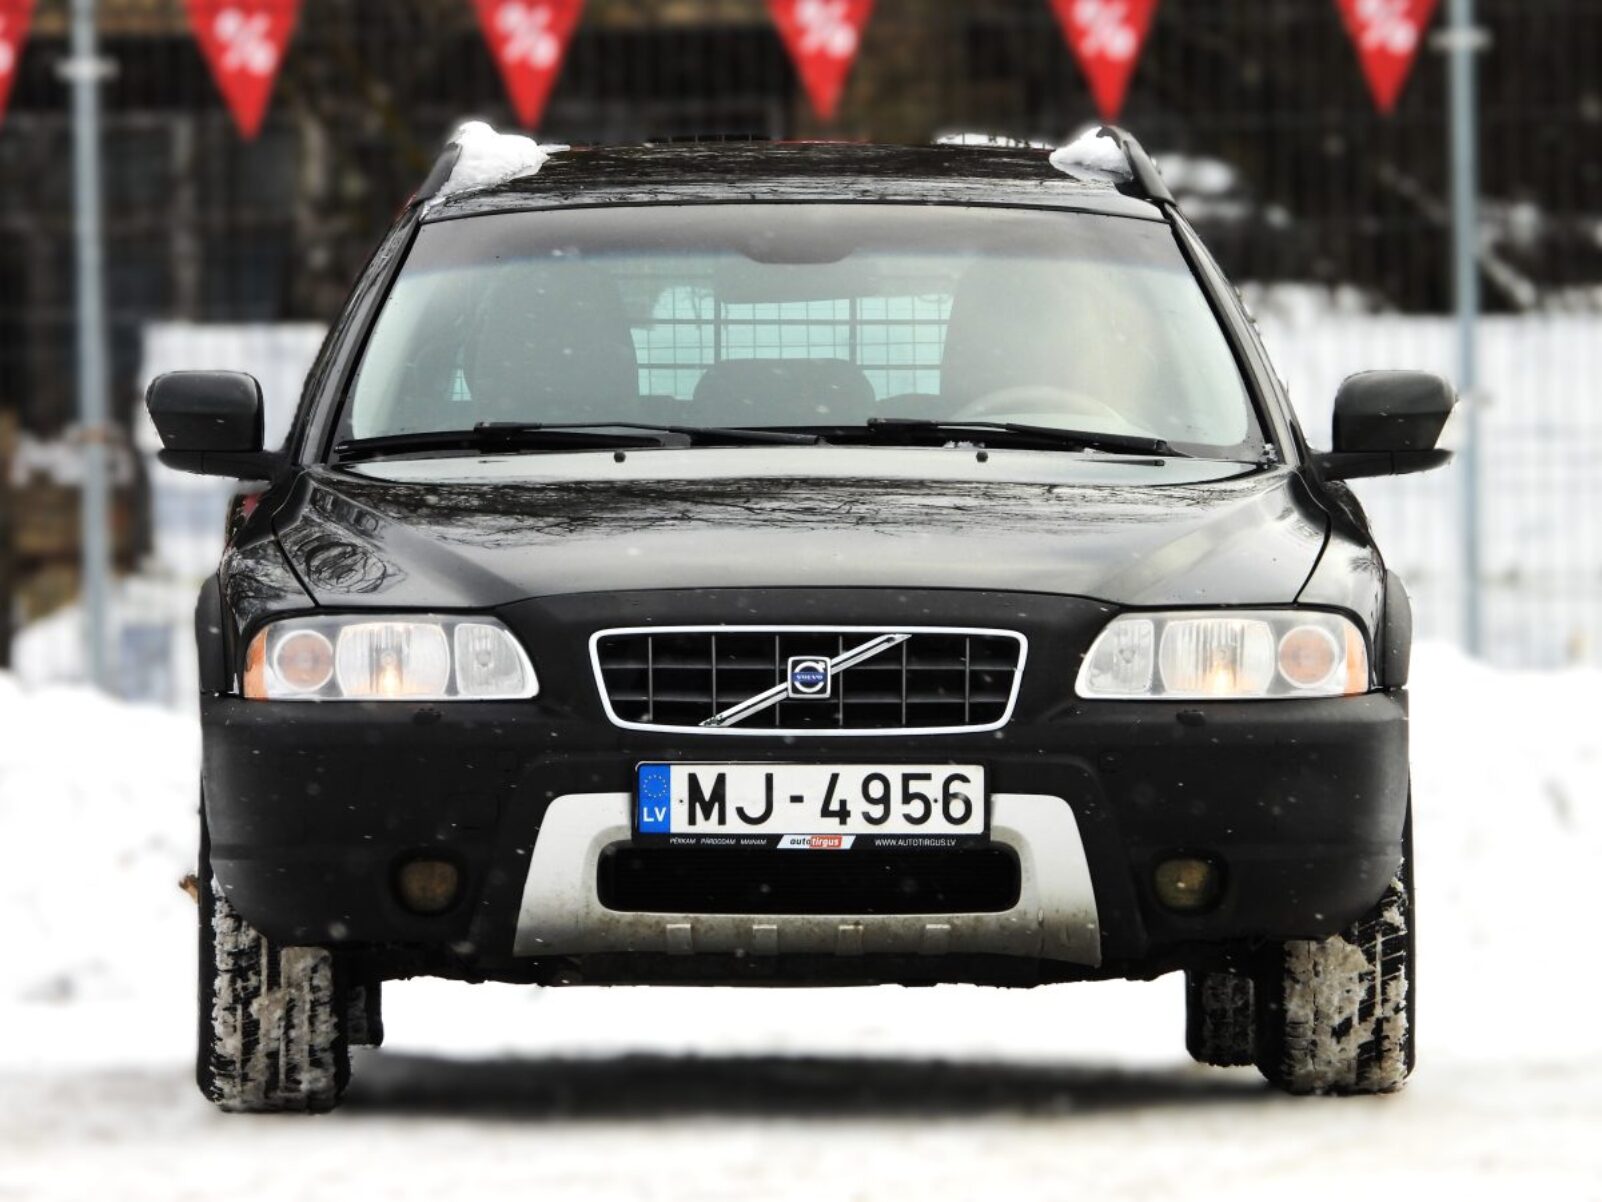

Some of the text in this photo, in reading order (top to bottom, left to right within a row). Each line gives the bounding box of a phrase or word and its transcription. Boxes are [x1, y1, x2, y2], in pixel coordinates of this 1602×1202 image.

[214, 8, 279, 76] %
[495, 1, 560, 69] %
[795, 0, 857, 59] %
[1073, 0, 1137, 61] %
[1355, 0, 1418, 55] %
[643, 806, 667, 822] LV
[687, 772, 973, 826] MJ-4956
[789, 837, 840, 848] autotirgus
